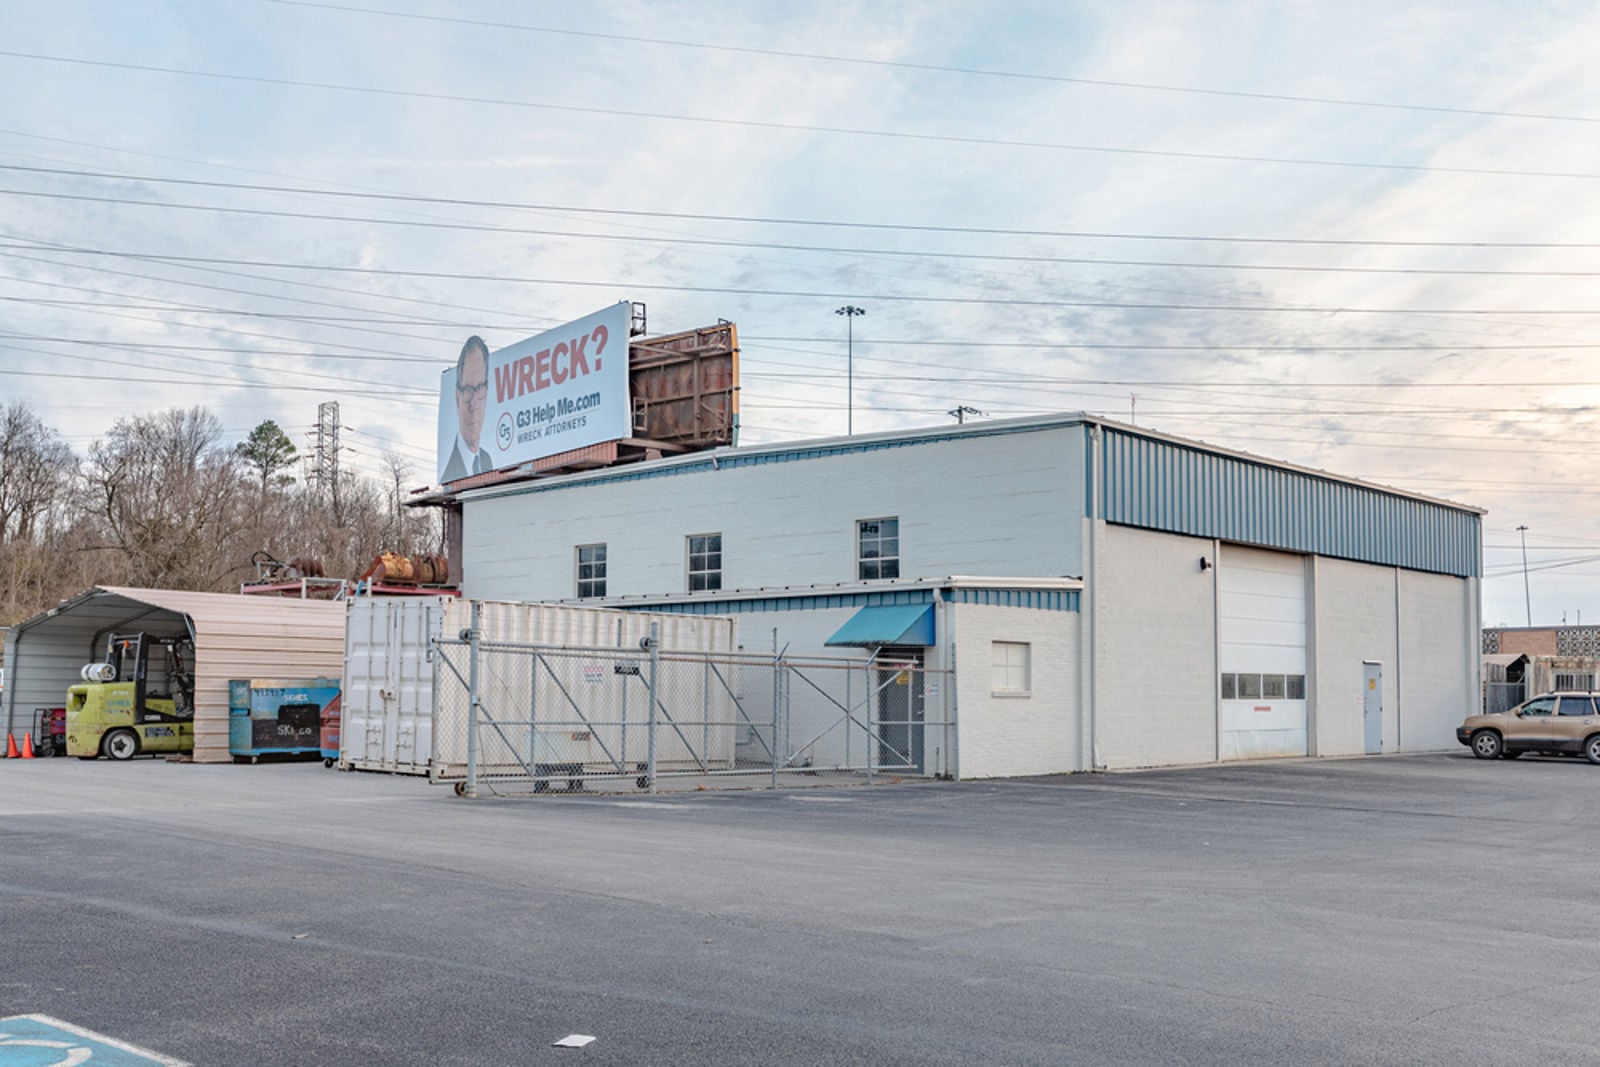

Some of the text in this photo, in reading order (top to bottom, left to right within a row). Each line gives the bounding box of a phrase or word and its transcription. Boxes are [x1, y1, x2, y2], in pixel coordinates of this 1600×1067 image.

[494, 324, 609, 404] WRECK?
[516, 391, 601, 429] G3 Help Me.com
[517, 415, 587, 444] WRECK ATTORNEYS
